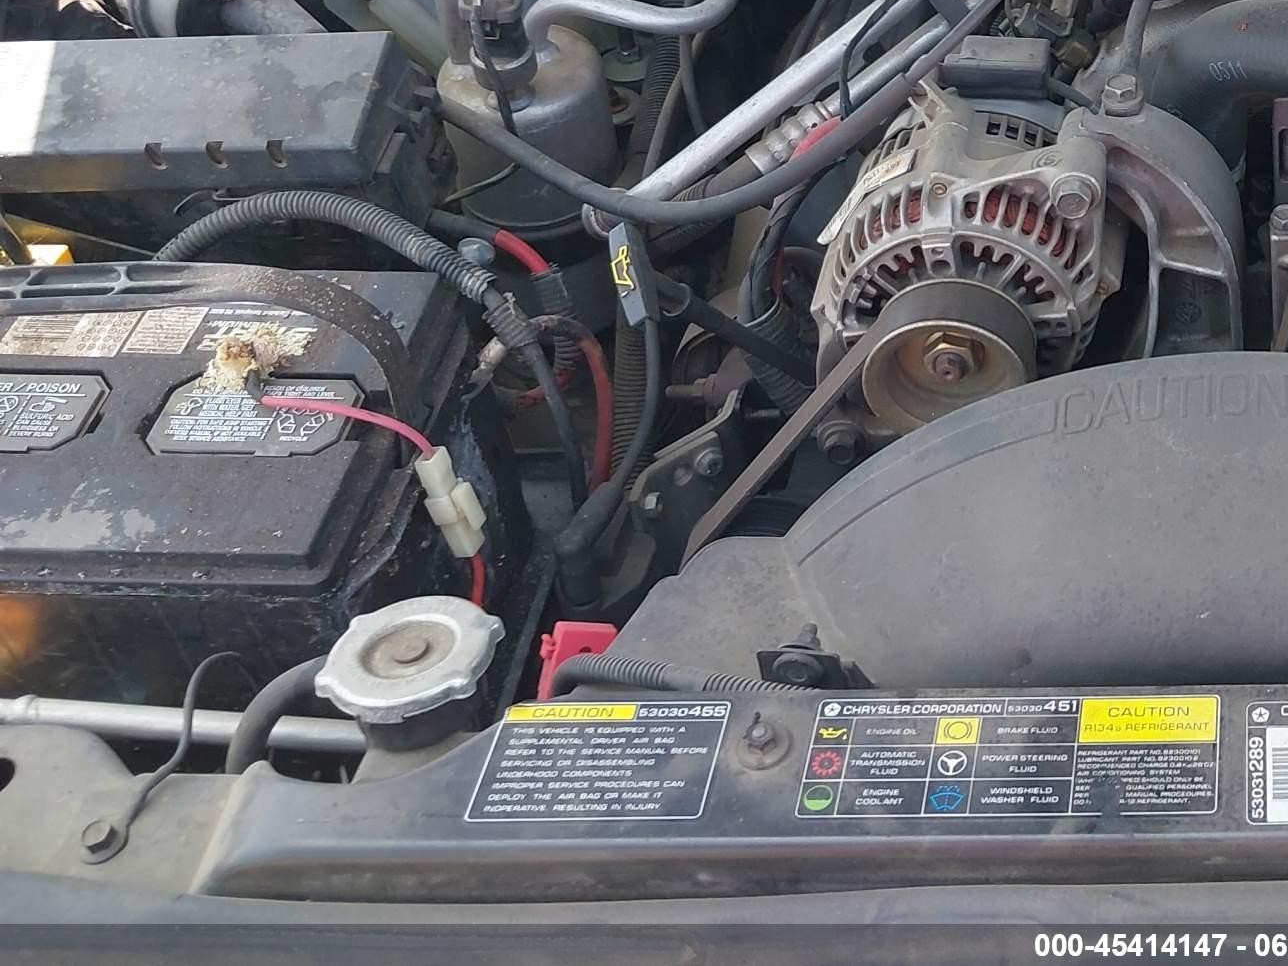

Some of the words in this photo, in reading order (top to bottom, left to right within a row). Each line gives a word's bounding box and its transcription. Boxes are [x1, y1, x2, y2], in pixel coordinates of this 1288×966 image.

[25, 382, 82, 394] POISON
[842, 704, 911, 716] CHRYSLER
[914, 703, 1003, 715] CORPORATION
[1007, 699, 1078, 713] 53030451
[531, 706, 615, 718] CAUTION
[638, 705, 727, 718] 53030455
[1107, 706, 1190, 718] CAUTION
[512, 726, 536, 735] THIS
[538, 726, 578, 735] VEHICLE
[597, 726, 646, 734] EQUIPPED
[996, 726, 1028, 735] BRAKE
[1030, 726, 1059, 735] FLUID
[1125, 721, 1210, 732] REFRIGERANT
[865, 728, 900, 736] ENGINE
[902, 728, 918, 736] OIL
[507, 737, 585, 746] SUPPLEMENTAL
[590, 737, 627, 745] DRIVER
[504, 748, 537, 756] REFER
[558, 747, 576, 755] THE
[580, 747, 621, 755] SERVICE
[624, 746, 666, 755] MANUAL
[670, 746, 709, 755] BEFORE
[860, 750, 917, 759] AUTOMATIC
[850, 758, 926, 767] TRANSMISSION
[981, 754, 1018, 762] POWER
[1018, 753, 1069, 762] STEERING
[499, 758, 553, 768] SERVICING
[575, 758, 656, 767] DISASSEMBLING
[495, 770, 559, 779] UNDERHOOD
[561, 769, 633, 778] COMPONENTS
[869, 767, 899, 776] FLUID
[1008, 764, 1038, 774] FLUID
[1249, 736, 1264, 819] 53031289
[491, 781, 544, 789] IMPROPER
[547, 781, 590, 789] SERVICE
[594, 780, 660, 788] PROCEDURES
[662, 780, 686, 788] CAN
[862, 787, 900, 796] ENGINE
[989, 786, 1054, 795] WINDSHIELD
[487, 792, 527, 802] DEPLOY
[533, 792, 553, 801] THE
[558, 792, 576, 800] AIR
[579, 792, 601, 800] BAG
[621, 791, 651, 799] MAKE
[855, 796, 905, 806] COOLANT
[980, 795, 1025, 805] WASHER
[1029, 795, 1060, 804] FLUID
[552, 803, 609, 812] RESULTING
